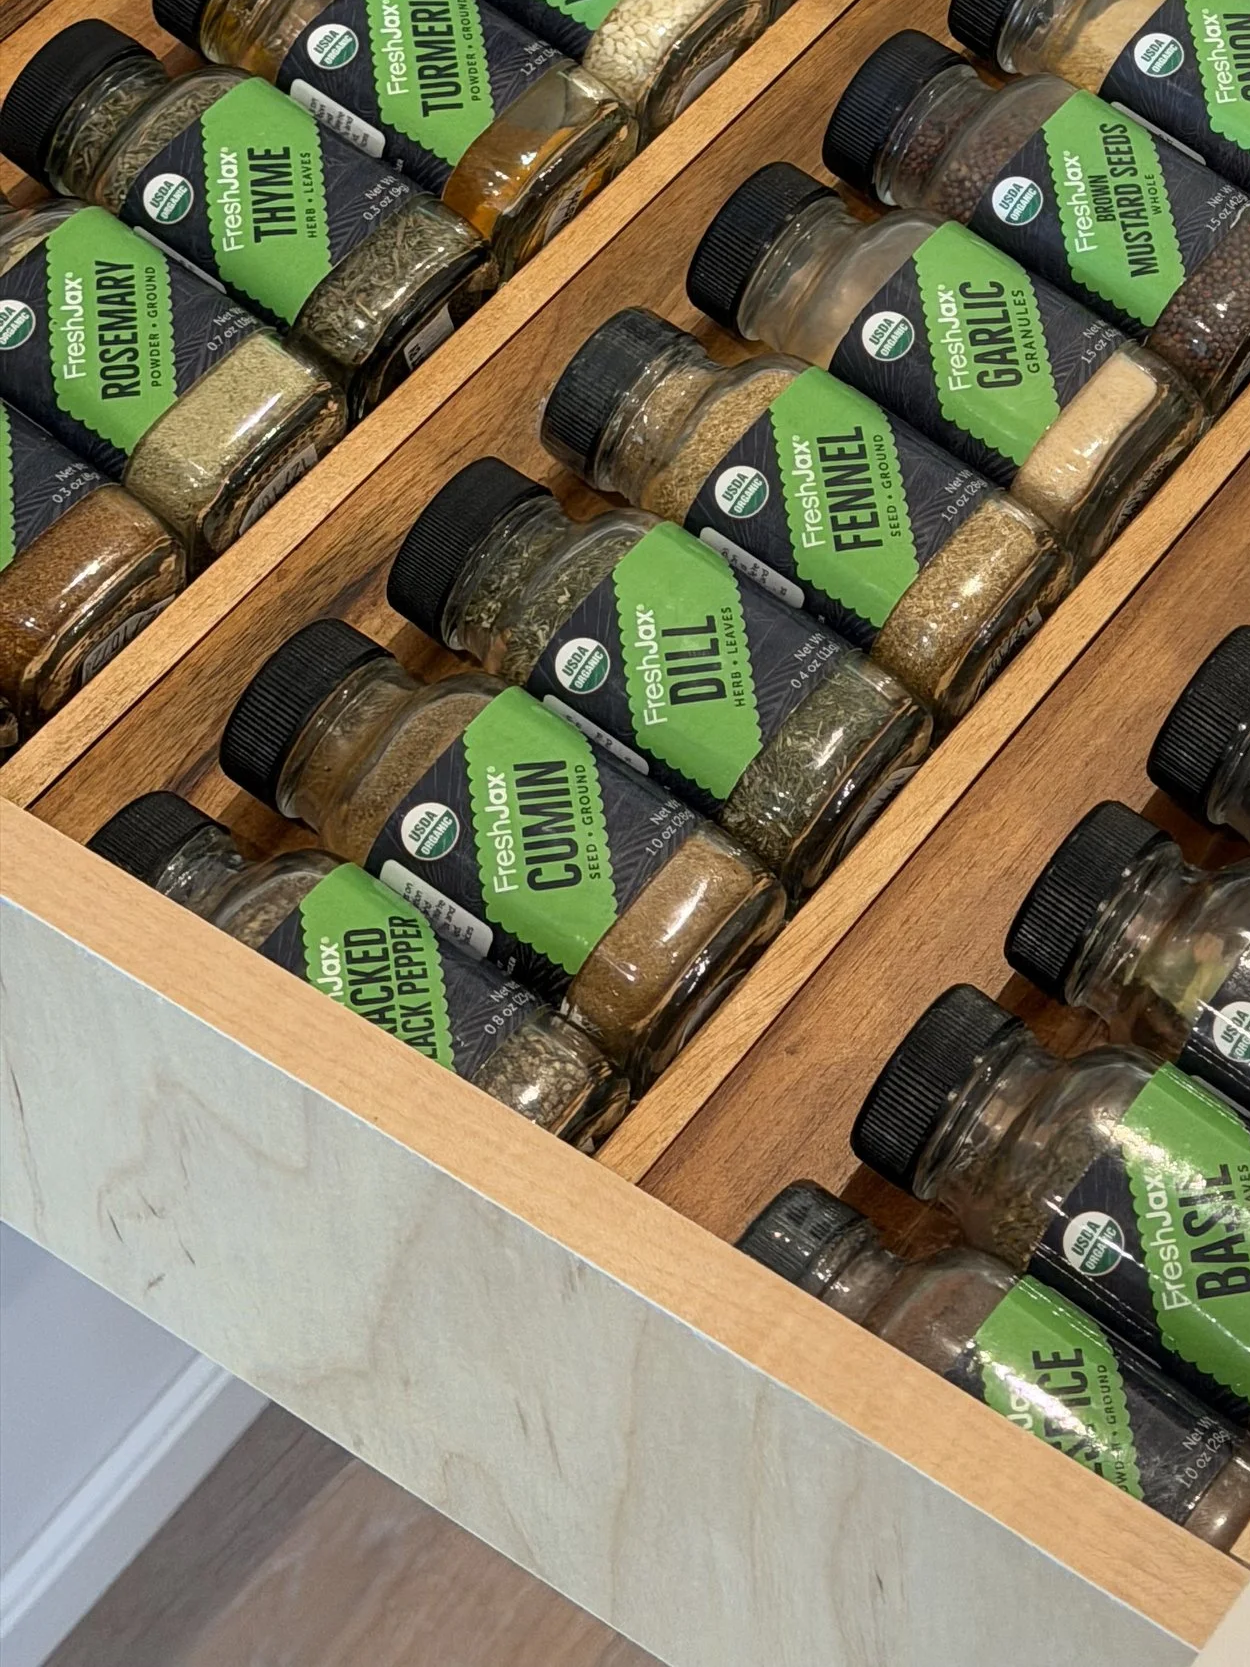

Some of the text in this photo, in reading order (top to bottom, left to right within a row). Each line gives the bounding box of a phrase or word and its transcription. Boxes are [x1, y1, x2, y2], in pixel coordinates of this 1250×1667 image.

[379, 0, 409, 96] FreshJax
[466, 52, 481, 101] POWDER
[1201, 9, 1237, 105] FreshJax
[150, 181, 174, 208] USDA
[161, 185, 189, 221] ORGANIC
[217, 147, 244, 253] FreshJax
[247, 146, 298, 243] THYME
[300, 152, 317, 239] HERB LEAVES
[1063, 151, 1097, 253] FreshJax
[1088, 174, 1117, 222] BROWN
[1100, 123, 1159, 279] MUSTARD SEEDS
[1144, 173, 1162, 215] WHOLE
[63, 272, 87, 381] FreshJax
[95, 260, 141, 401] ROSEMARY
[144, 266, 162, 387] POWDER GROUND
[937, 284, 972, 391] FreshJax
[958, 281, 1023, 389] GARLIC
[1013, 290, 1041, 374] GRANULES
[791, 435, 826, 549] FreshJax
[817, 426, 883, 553] FENNEL
[873, 434, 902, 537] SEED GROUND
[634, 603, 668, 726] FreshJax
[661, 615, 727, 706] DILL
[721, 607, 746, 708] HERB LEAVES
[486, 766, 518, 894] FreshJax
[513, 761, 582, 891] CUMIN
[575, 764, 601, 879] SEED GROUND
[389, 916, 437, 1059] LACK PEPPER
[1097, 1364, 1117, 1425] GROUND
